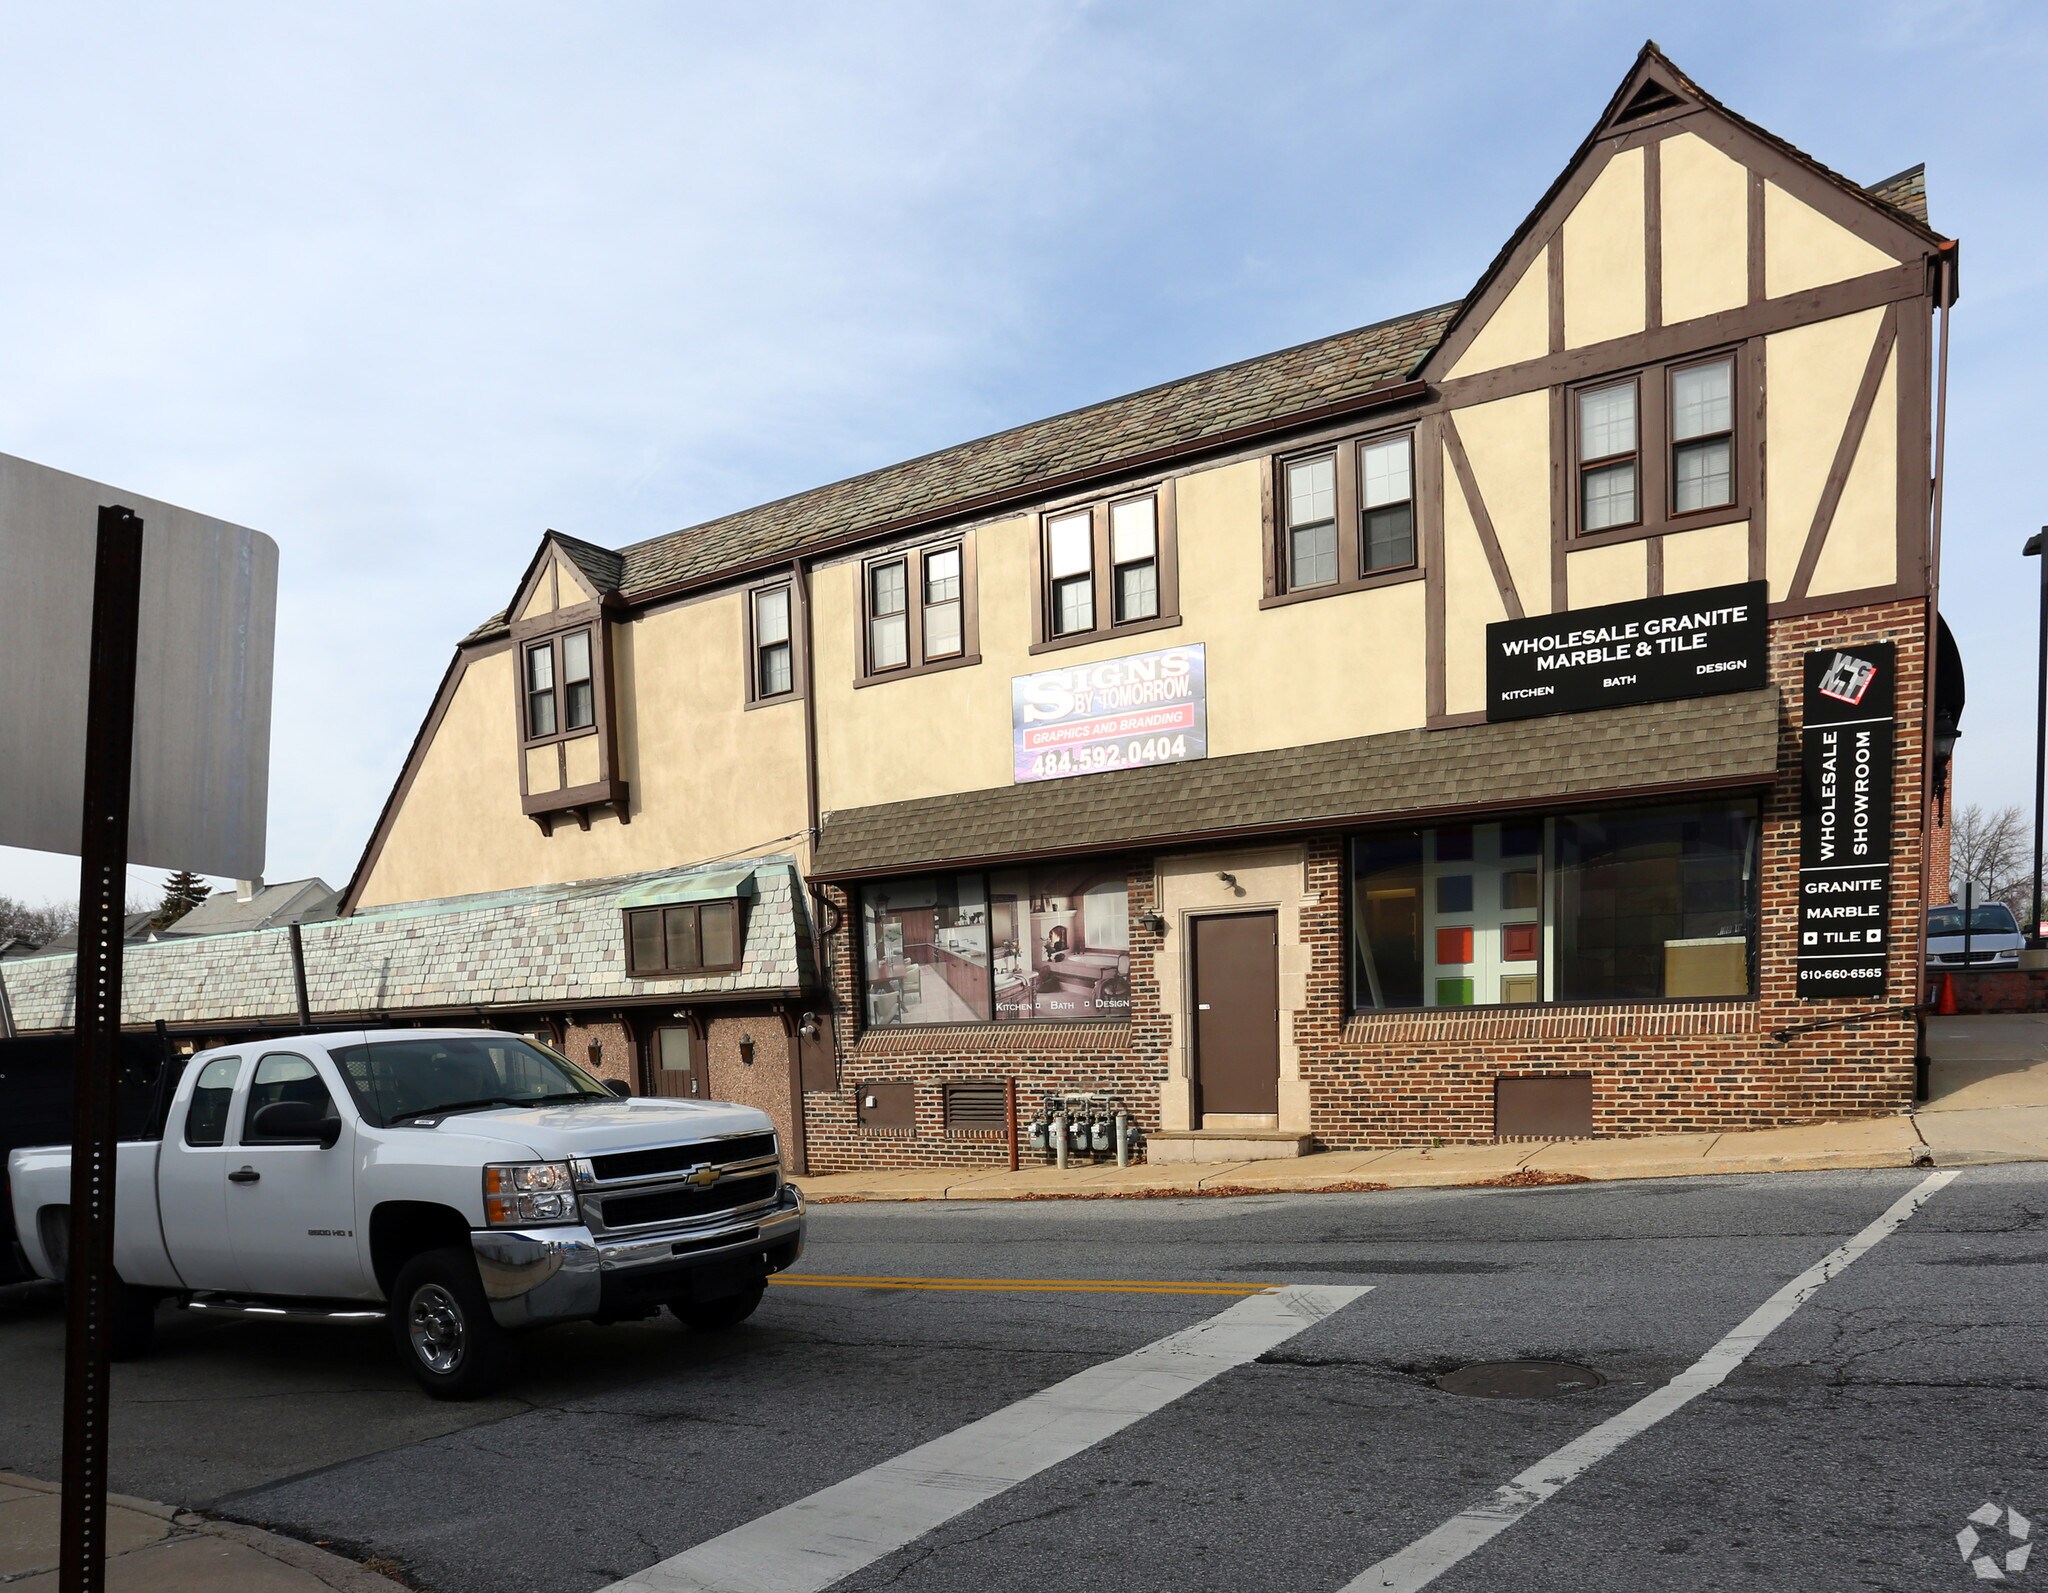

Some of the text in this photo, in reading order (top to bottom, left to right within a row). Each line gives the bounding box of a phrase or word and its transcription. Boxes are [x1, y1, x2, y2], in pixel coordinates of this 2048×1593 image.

[1502, 605, 1748, 656] WHOLESALE GRANITE
[1536, 632, 1708, 672] MARBLE & TILE
[1022, 651, 1190, 723] SIGNS
[1501, 659, 1748, 701] KITCHEN BATH DESIGN
[1075, 692, 1094, 713] BY
[1032, 710, 1184, 745] GRAPHICS AND BRANDING
[1031, 734, 1187, 777] 484.592.0404
[1820, 731, 1838, 861] WHOLESALE
[1853, 731, 1871, 856] SHOWROOM
[1804, 879, 1883, 894] GRANITE
[1806, 905, 1881, 920] MARBLE
[1823, 931, 1862, 944] TILE
[1800, 968, 1883, 980] 610-660-6565
[995, 999, 1130, 1012] KITCHEN BATH DESIGN
